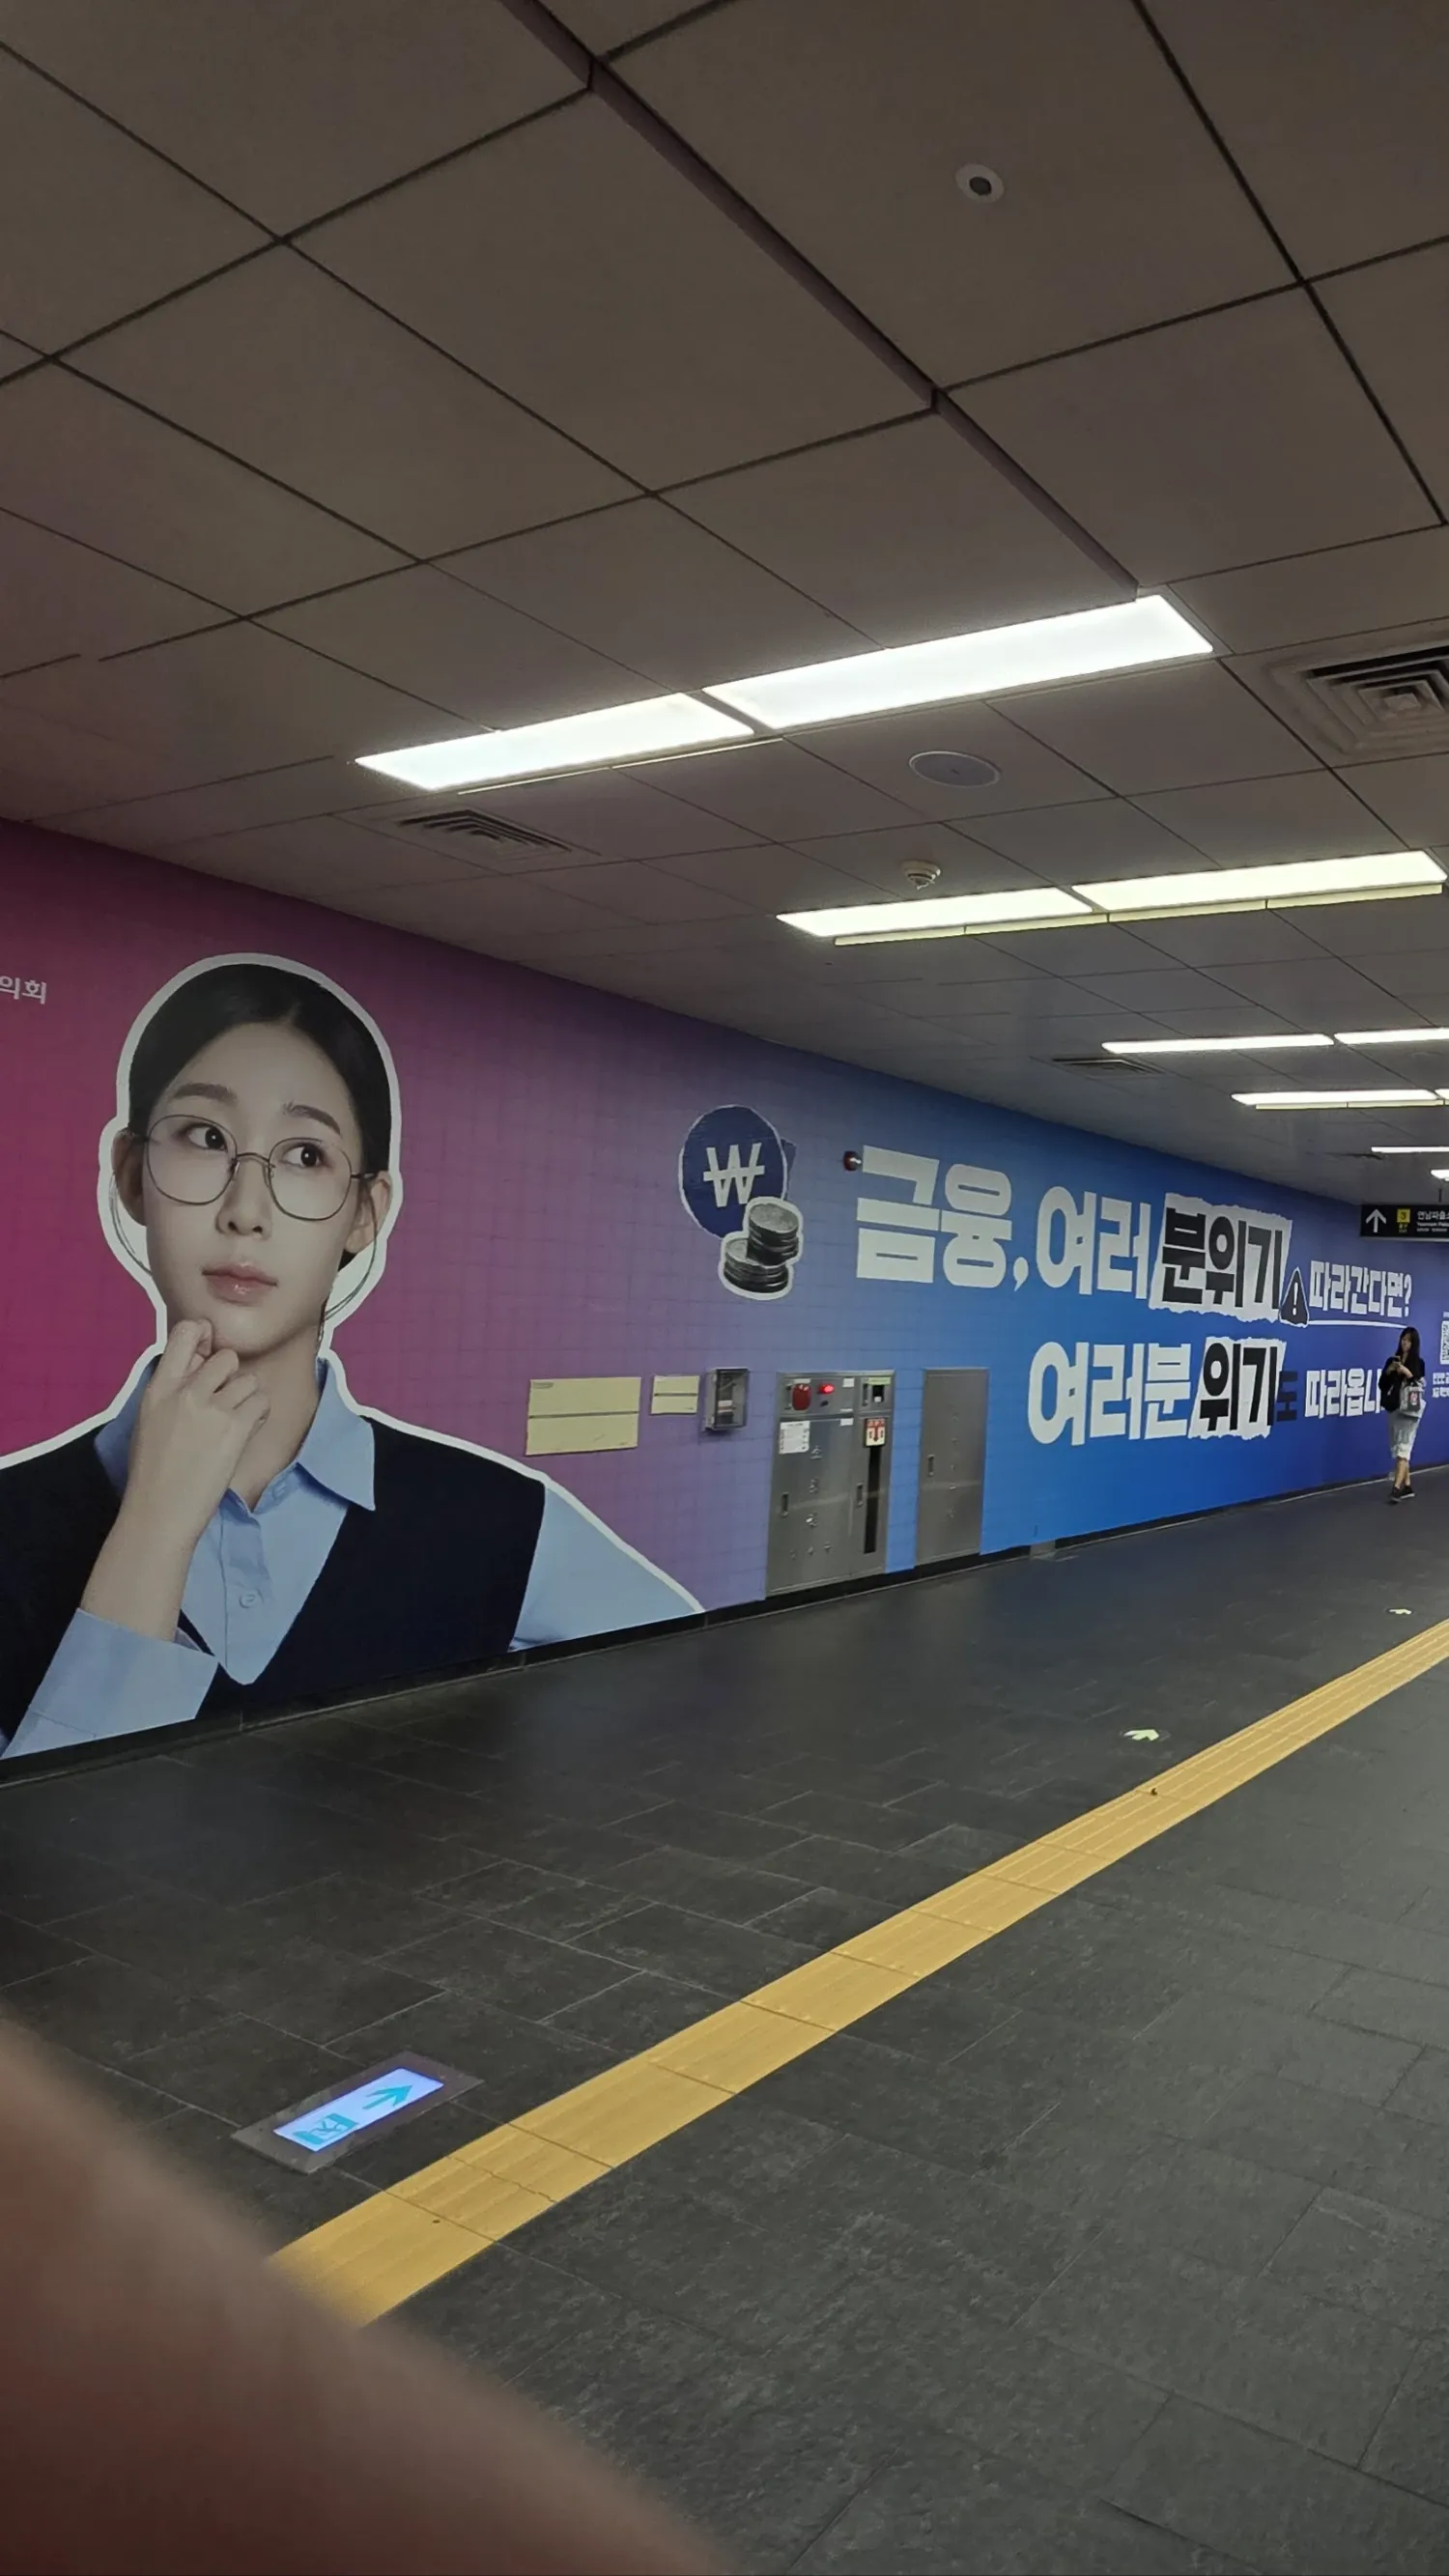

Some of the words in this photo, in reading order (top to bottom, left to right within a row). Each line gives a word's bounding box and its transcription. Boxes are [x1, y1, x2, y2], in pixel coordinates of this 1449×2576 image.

[856, 1146, 1030, 1290] 금융,
[1310, 1260, 1412, 1316] 따라간다면?
[1028, 1341, 1192, 1446] 여러분
[1304, 1368, 1384, 1419] 따라옵니
